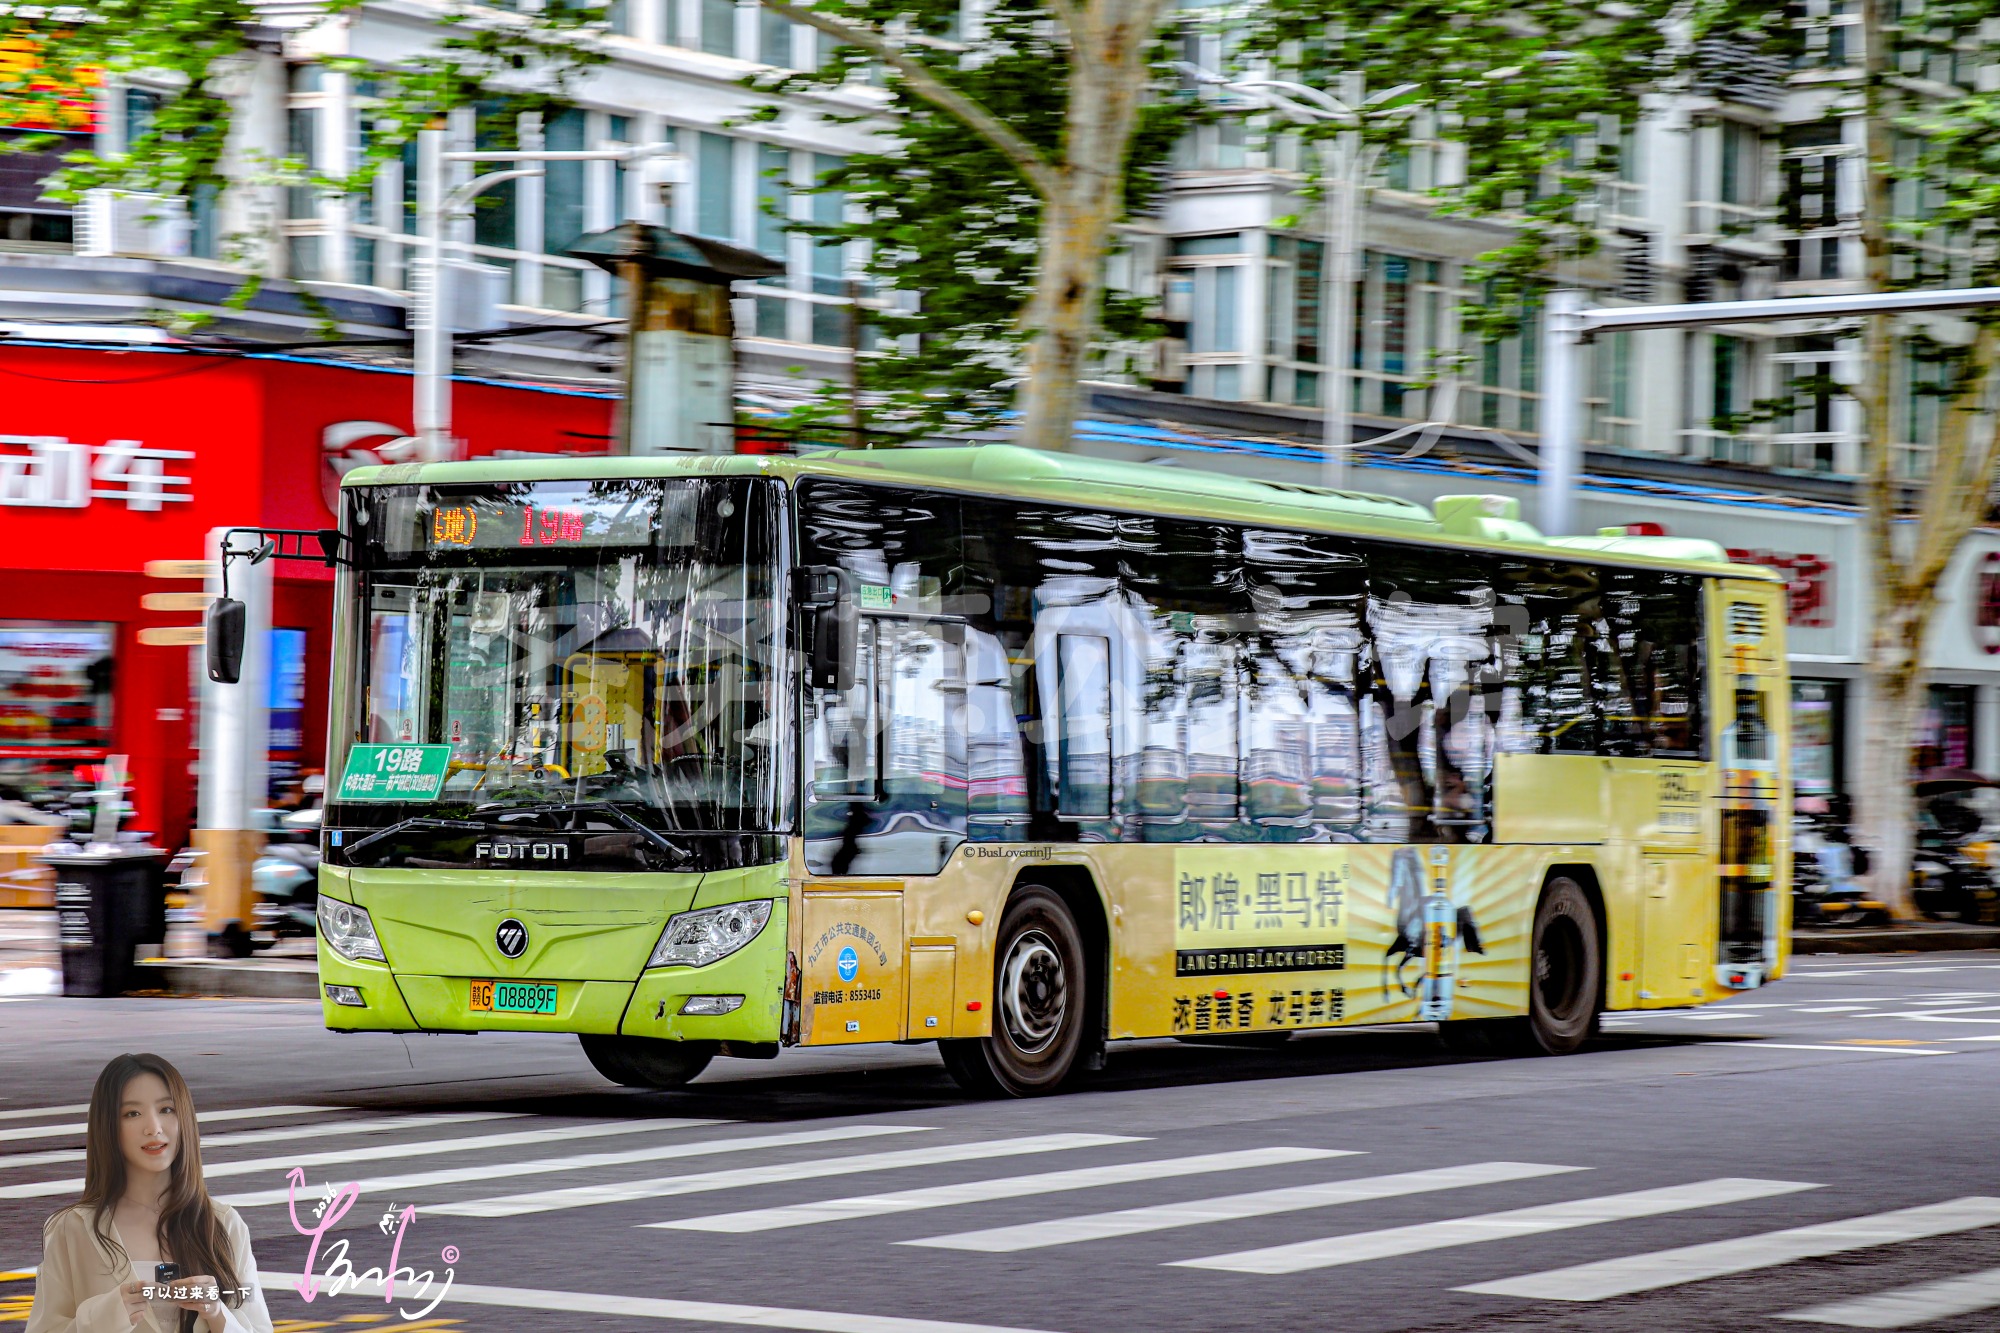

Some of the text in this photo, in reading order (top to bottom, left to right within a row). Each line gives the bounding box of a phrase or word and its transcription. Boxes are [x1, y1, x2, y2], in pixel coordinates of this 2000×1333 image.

[374, 748, 424, 772] 19路
[476, 843, 568, 859] FOTON
[808, 922, 888, 967] 九江市公共交通集团公司
[1177, 949, 1345, 971] LANG PAI BLACK HORSE
